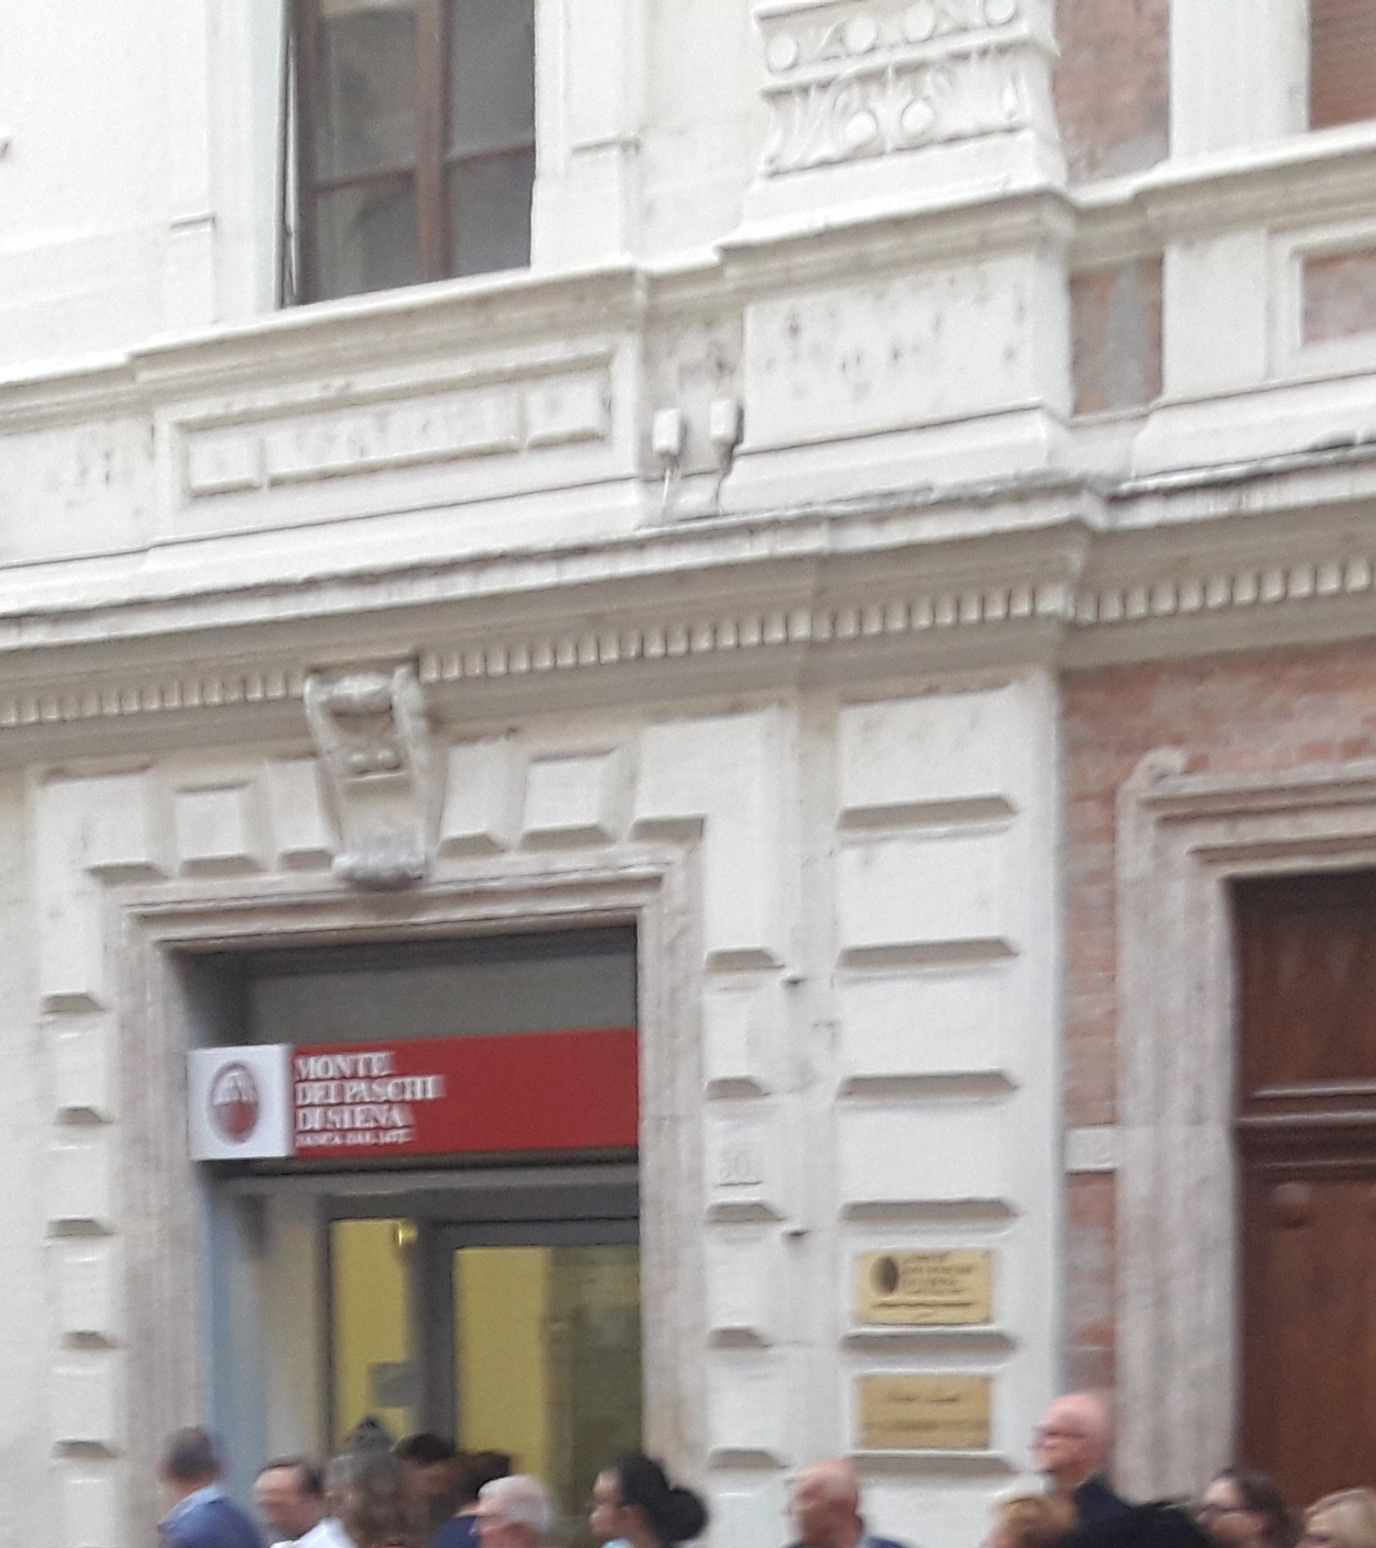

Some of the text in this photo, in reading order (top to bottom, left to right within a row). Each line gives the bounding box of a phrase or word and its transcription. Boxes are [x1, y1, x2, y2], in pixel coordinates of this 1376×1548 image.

[295, 1053, 393, 1079] MONTE
[344, 1074, 445, 1101] PASCHI
[295, 1103, 414, 1130] DI SIENA
